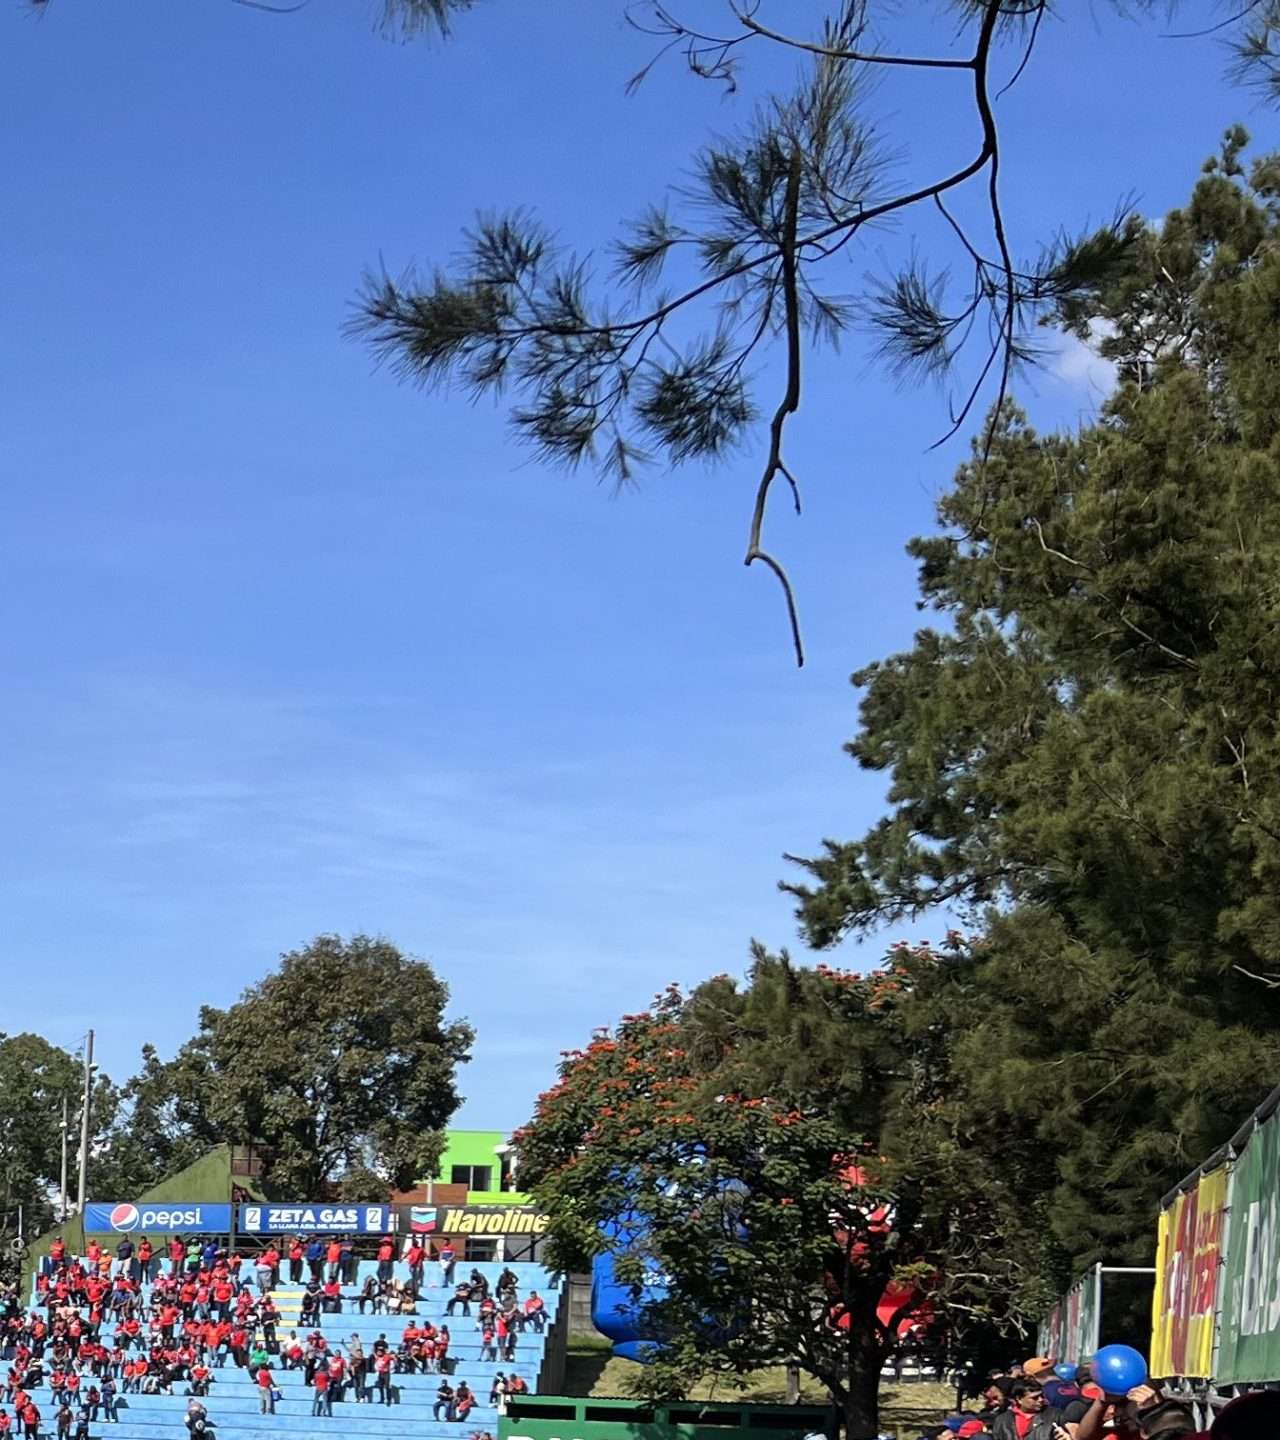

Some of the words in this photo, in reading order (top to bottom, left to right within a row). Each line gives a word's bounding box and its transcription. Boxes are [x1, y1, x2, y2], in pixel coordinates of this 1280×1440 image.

[142, 1208, 202, 1229] pepsi
[269, 1209, 315, 1223] ZETA
[320, 1209, 358, 1223] GAS
[443, 1209, 550, 1233] Havoline
